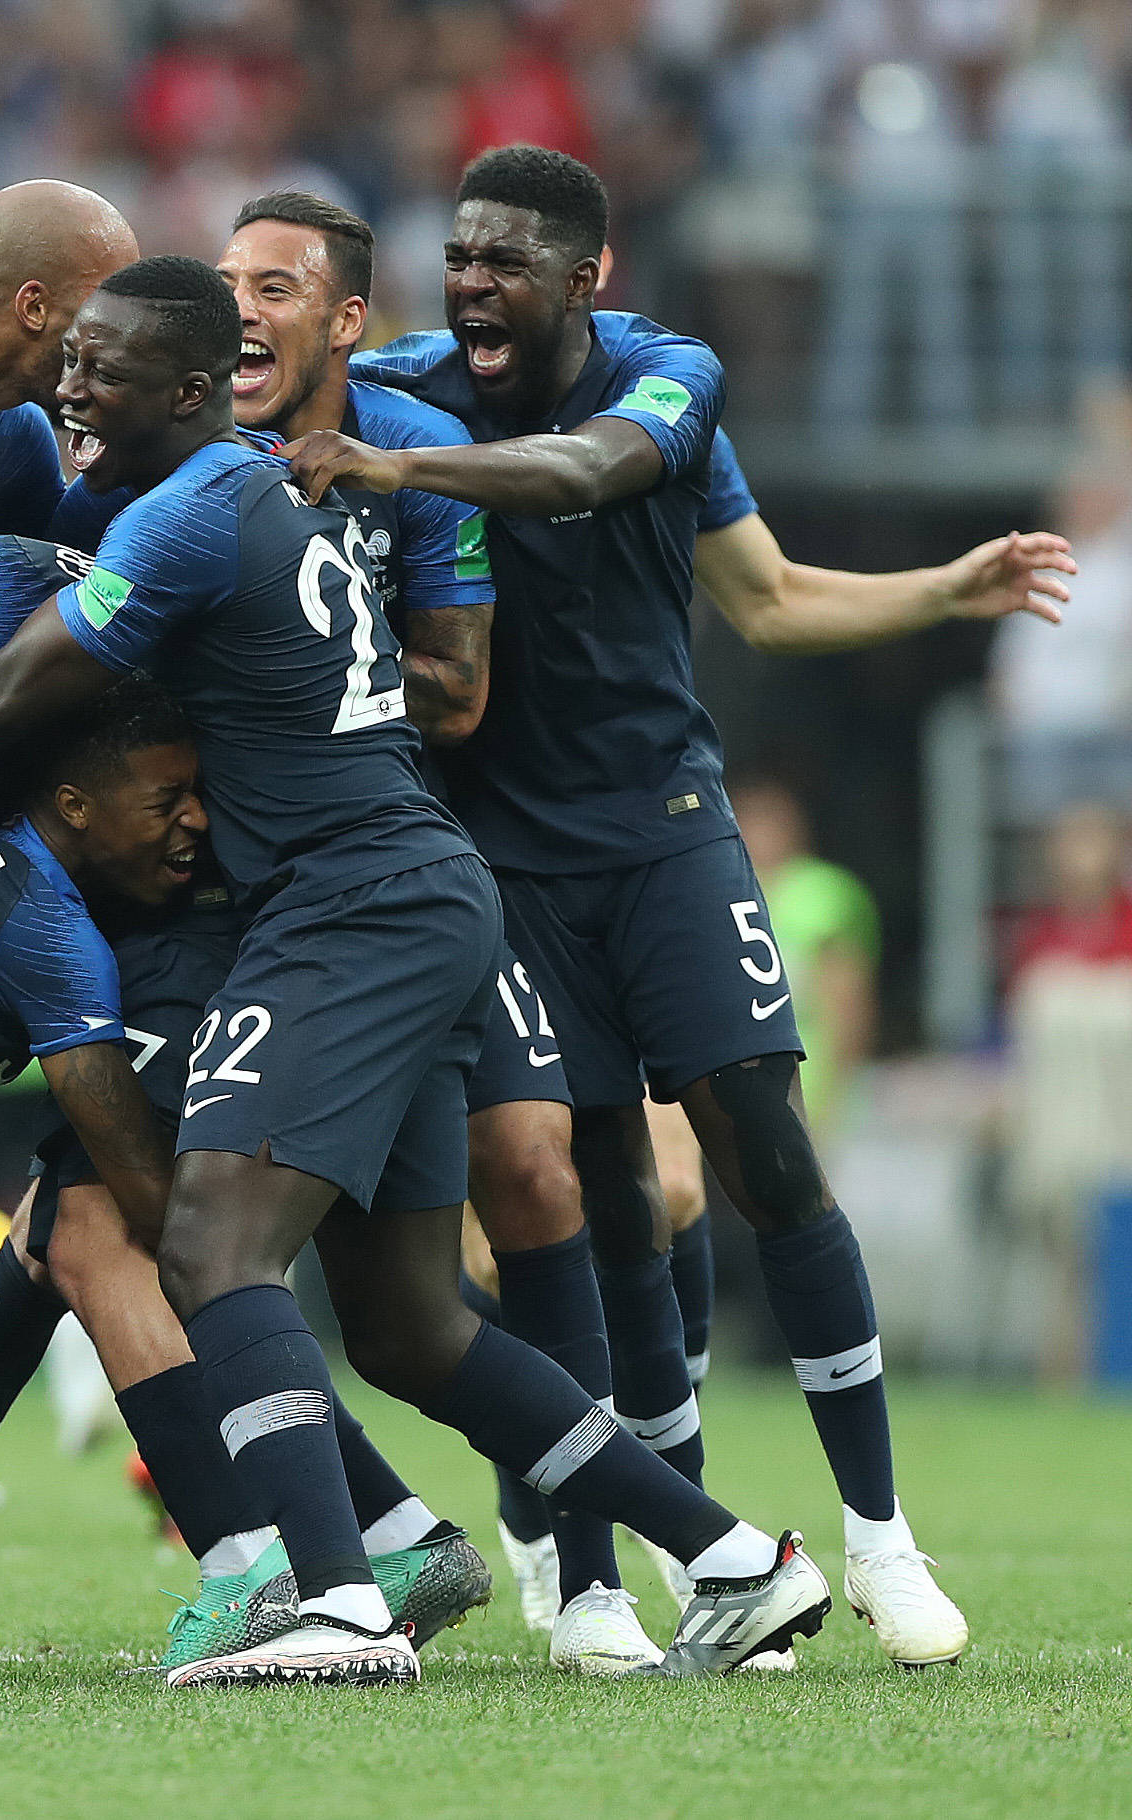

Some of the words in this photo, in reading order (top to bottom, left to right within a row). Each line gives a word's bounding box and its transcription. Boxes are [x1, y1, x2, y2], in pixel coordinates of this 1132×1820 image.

[729, 901, 782, 985] 5
[496, 961, 556, 1038] 12
[186, 1005, 273, 1089] 22
